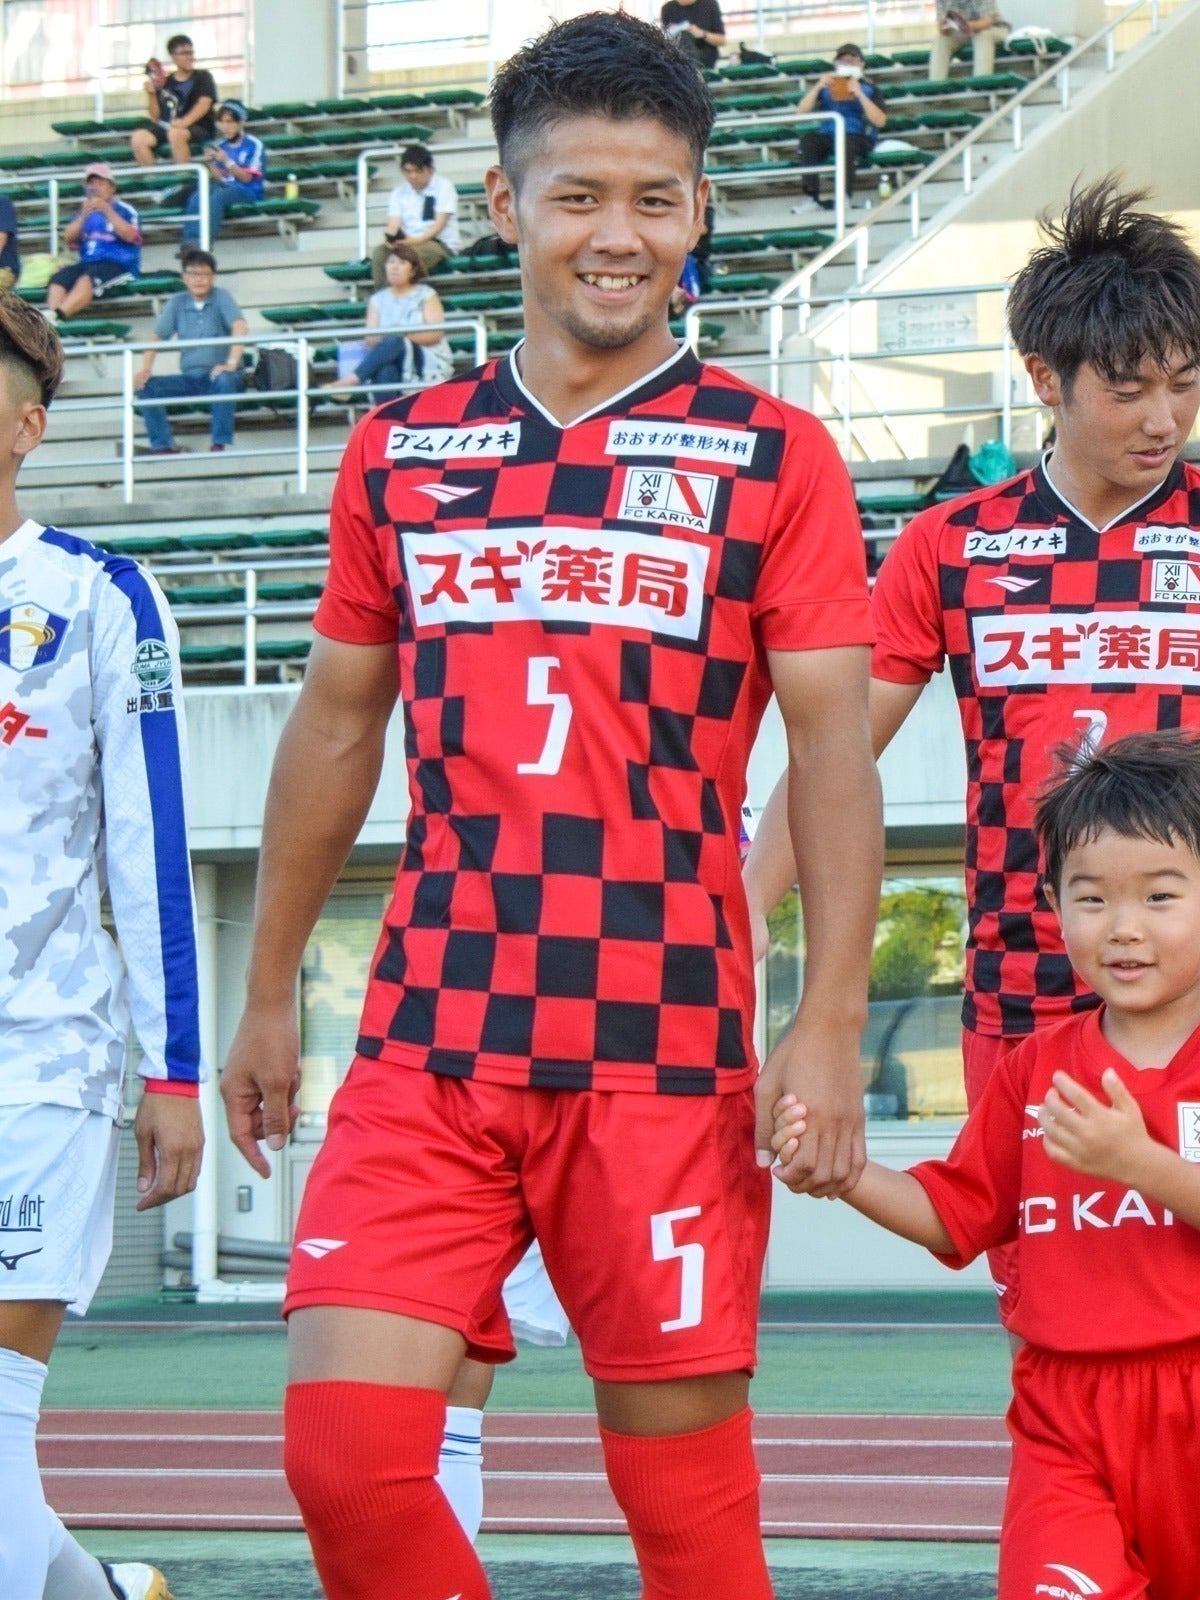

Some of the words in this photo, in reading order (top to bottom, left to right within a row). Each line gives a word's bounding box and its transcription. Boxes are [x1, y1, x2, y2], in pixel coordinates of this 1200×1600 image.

[391, 430, 516, 452] ゴムノイナキ
[613, 431, 748, 455] おおすが整形外科
[624, 509, 643, 518] FC
[647, 510, 704, 529] KARIYA
[968, 533, 1064, 553] ゴムノイナキ
[416, 540, 688, 618] スギ薬局
[1154, 592, 1170, 600] FC
[517, 656, 573, 775] 5
[19, 1194, 46, 1227] Art
[1072, 1189, 1174, 1231] KA
[650, 1205, 705, 1333] 5
